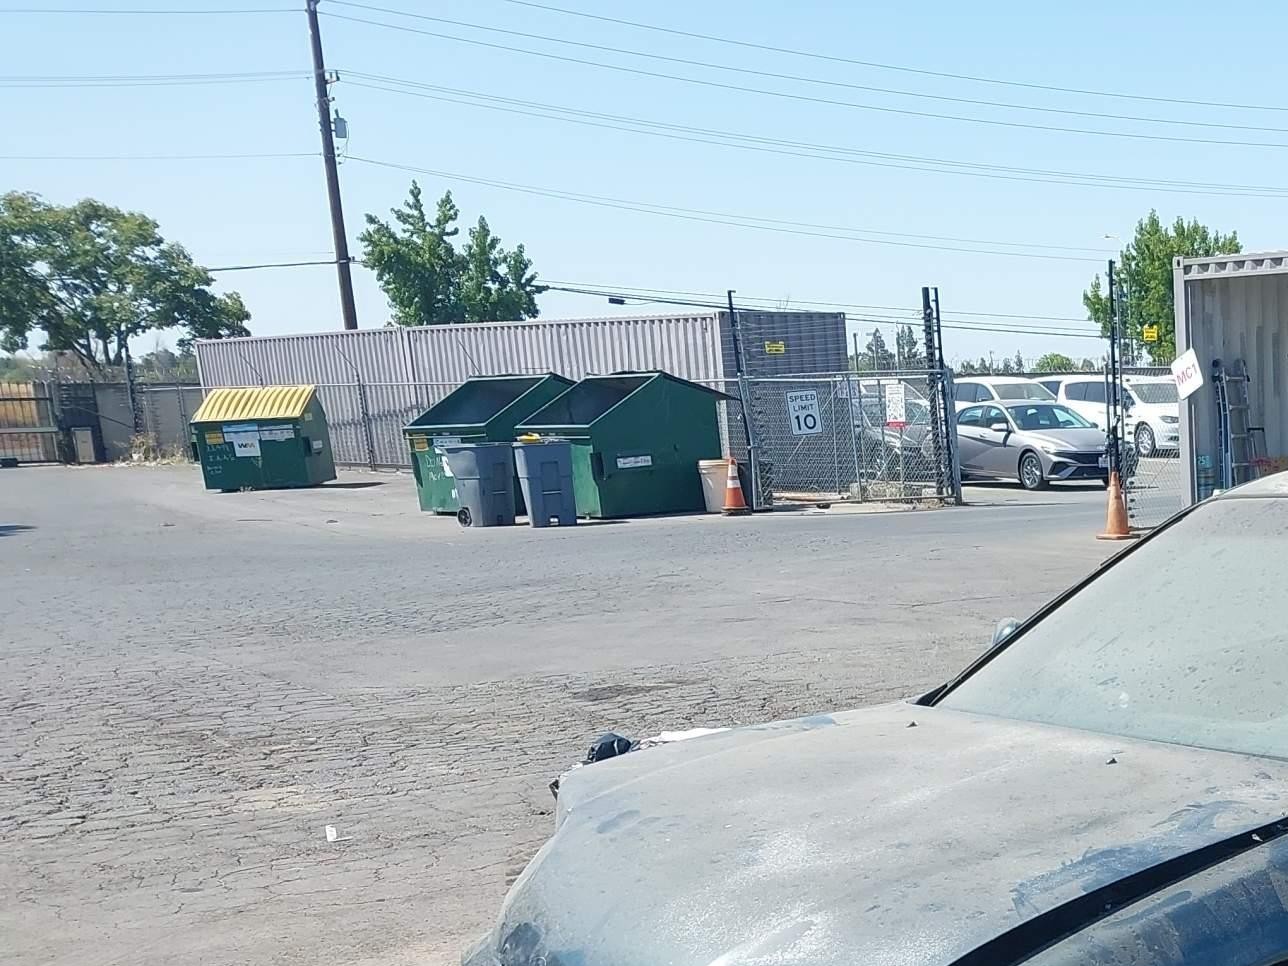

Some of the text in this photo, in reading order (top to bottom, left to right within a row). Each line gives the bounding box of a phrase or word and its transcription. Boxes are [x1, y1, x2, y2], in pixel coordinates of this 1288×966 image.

[1176, 363, 1198, 386] MC1
[788, 393, 816, 404] SPEED
[793, 403, 815, 412] LIMIT
[794, 413, 817, 432] 10
